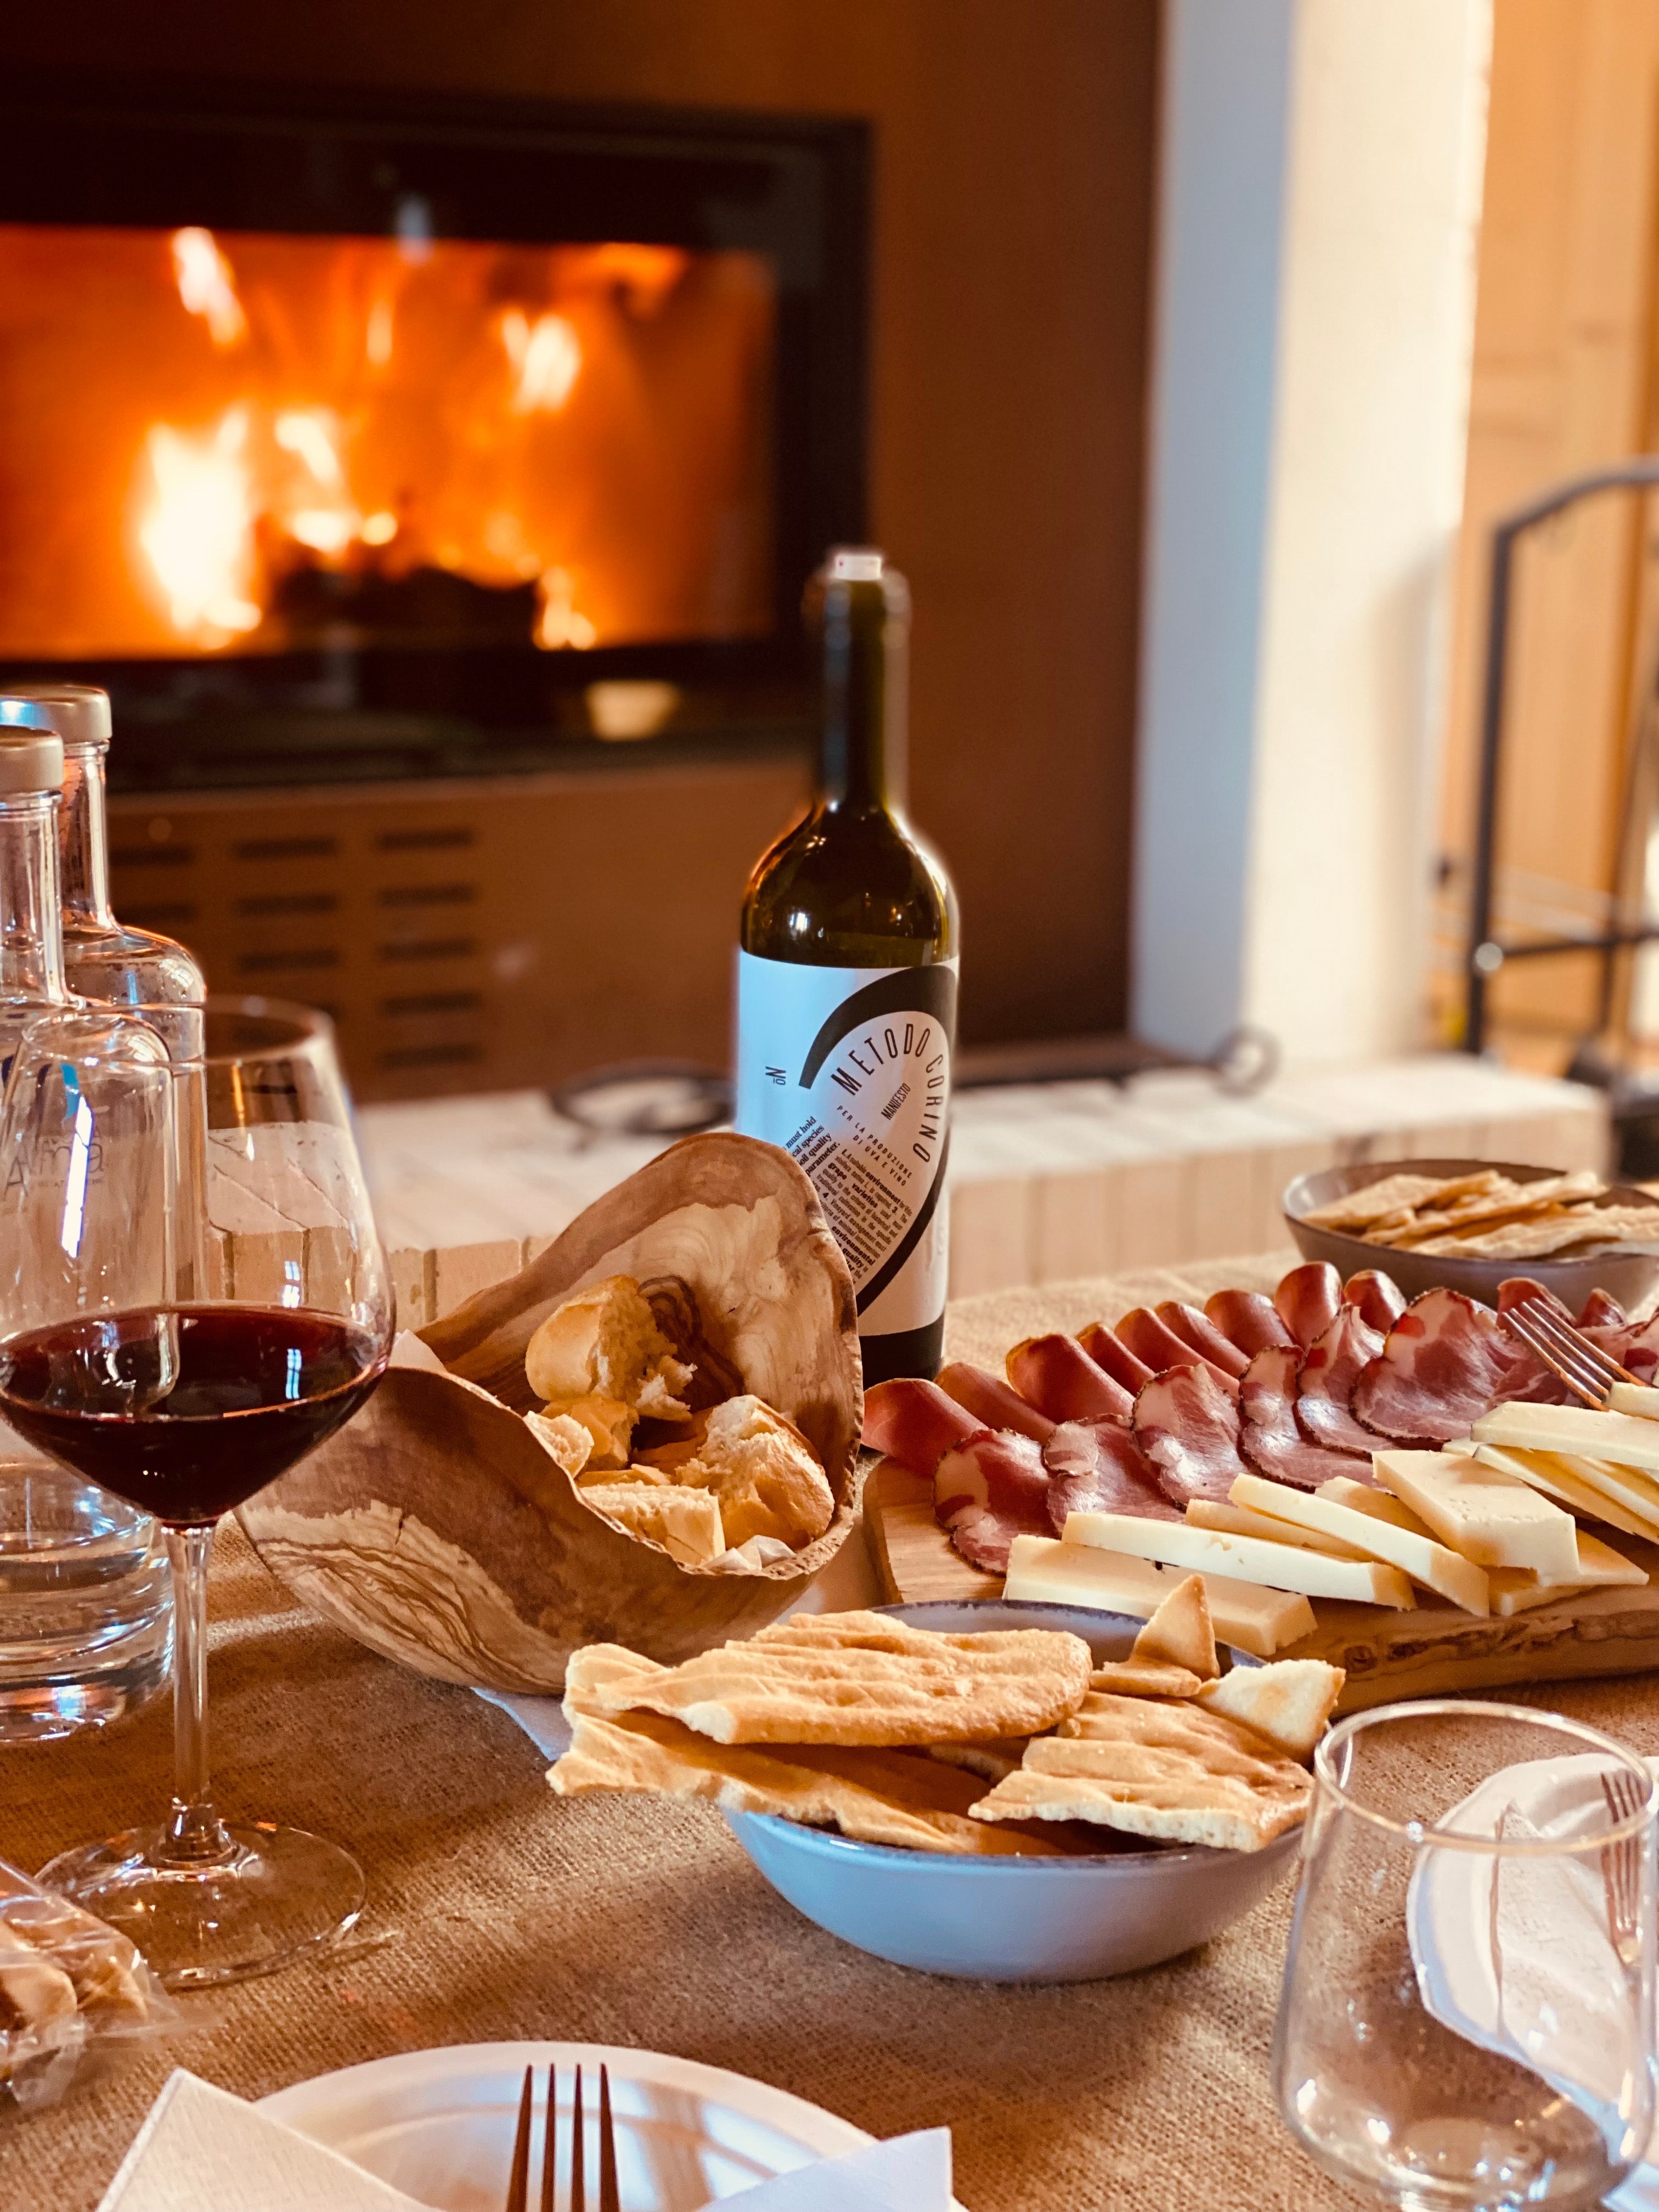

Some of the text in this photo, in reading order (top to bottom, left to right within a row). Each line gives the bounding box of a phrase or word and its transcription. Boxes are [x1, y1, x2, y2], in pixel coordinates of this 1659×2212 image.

[831, 1024, 944, 1162] METODO CORINO
[881, 1083, 911, 1120] MANIFESTO
[786, 1116, 816, 1148] must hold
[802, 1126, 824, 1148] species
[809, 1133, 832, 1156] quality
[837, 1105, 912, 1178] PER LA PRODUZIONE
[805, 1142, 840, 1177] parameter.
[853, 1135, 863, 1144] DI
[865, 1146, 880, 1161] UVA
[889, 1168, 906, 1186] VINO
[817, 1174, 839, 1196] traditional
[828, 1163, 847, 1180] grape
[853, 1183, 878, 1208] varieties
[866, 1172, 901, 1205] environment
[831, 1199, 851, 1219] Vineyard
[849, 1218, 876, 1243] management
[832, 1227, 876, 1266] environmental
[843, 1249, 864, 1268] quality
